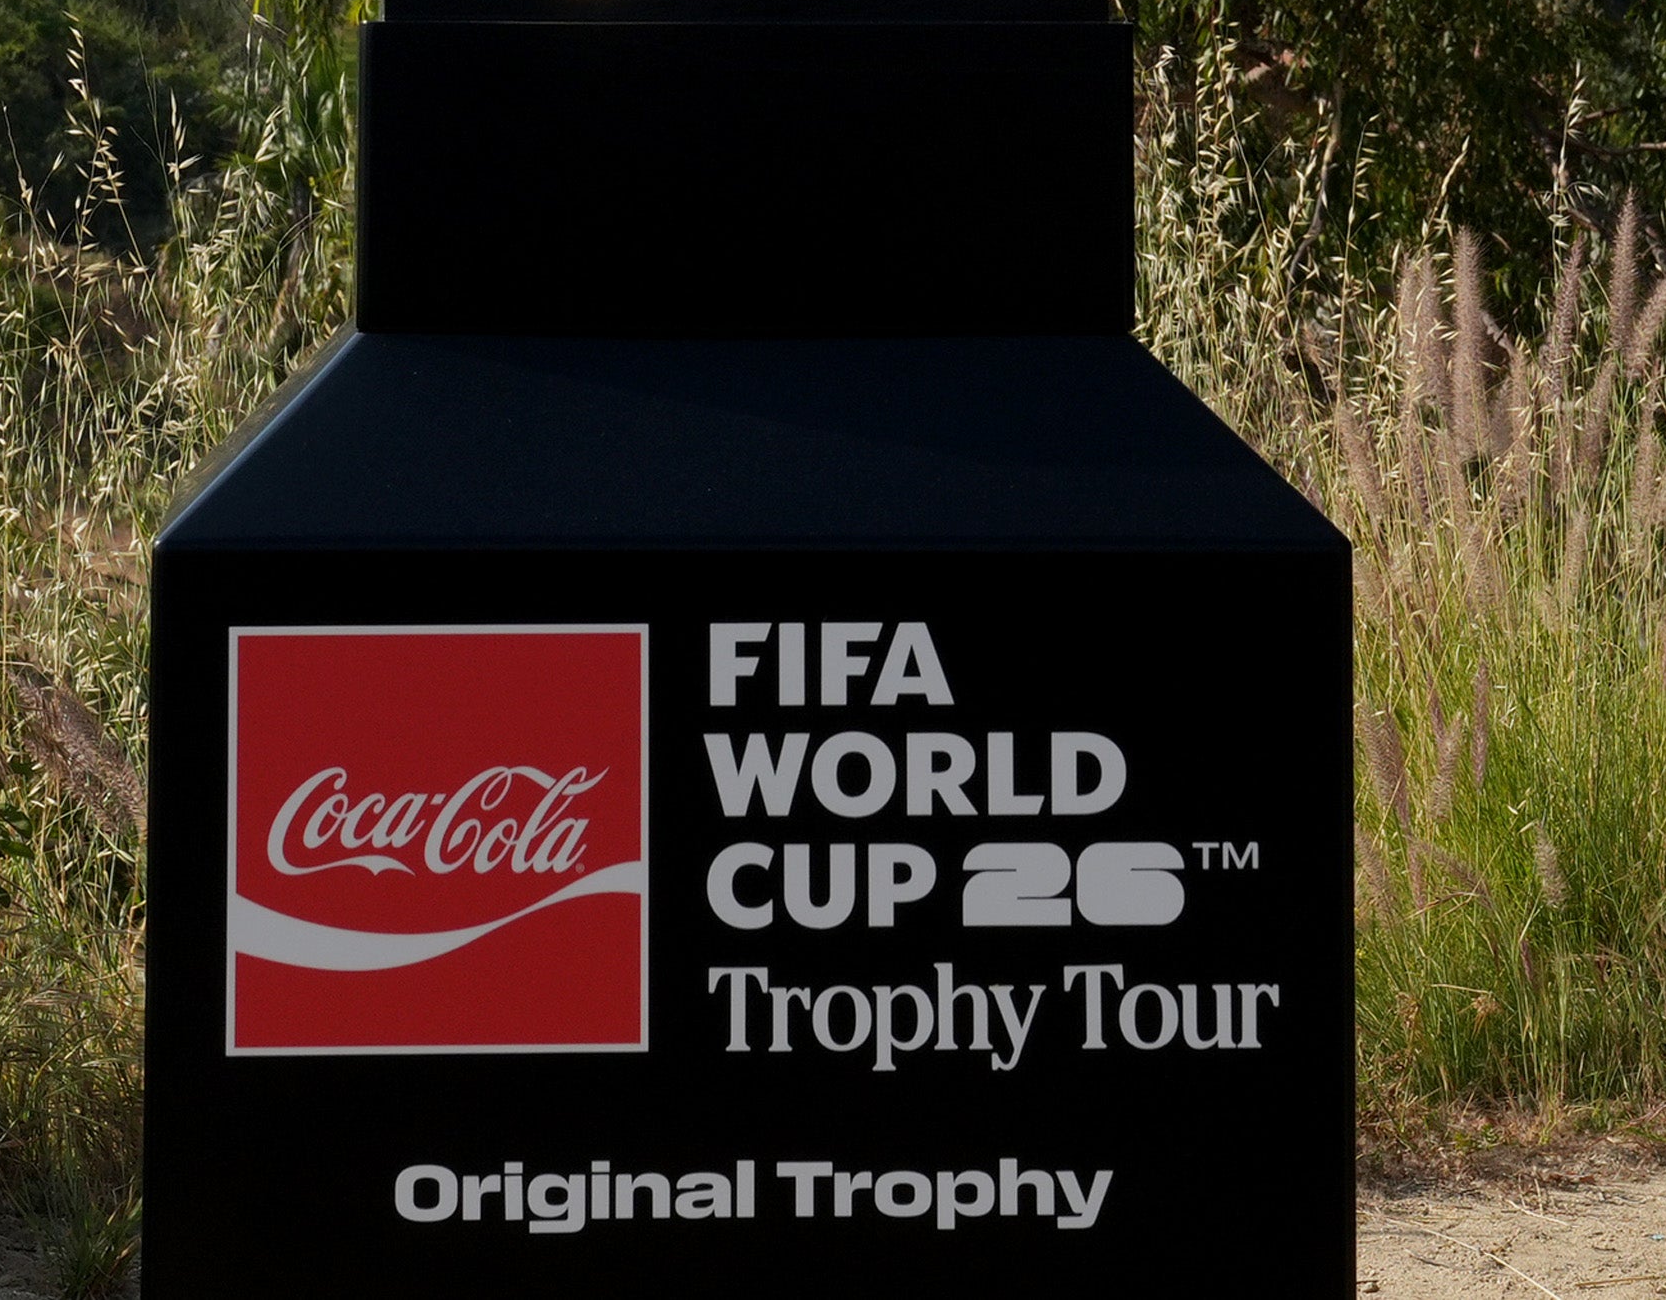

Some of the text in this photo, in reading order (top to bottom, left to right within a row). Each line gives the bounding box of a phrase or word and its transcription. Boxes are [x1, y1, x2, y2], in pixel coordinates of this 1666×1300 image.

[710, 622, 955, 707] FIFA
[704, 732, 1127, 819] WORLD
[267, 765, 610, 876] Coca-Cola
[707, 843, 938, 931] CUP
[709, 963, 1281, 1072] Trophy Tour
[395, 1158, 1115, 1235] Original Trophy
